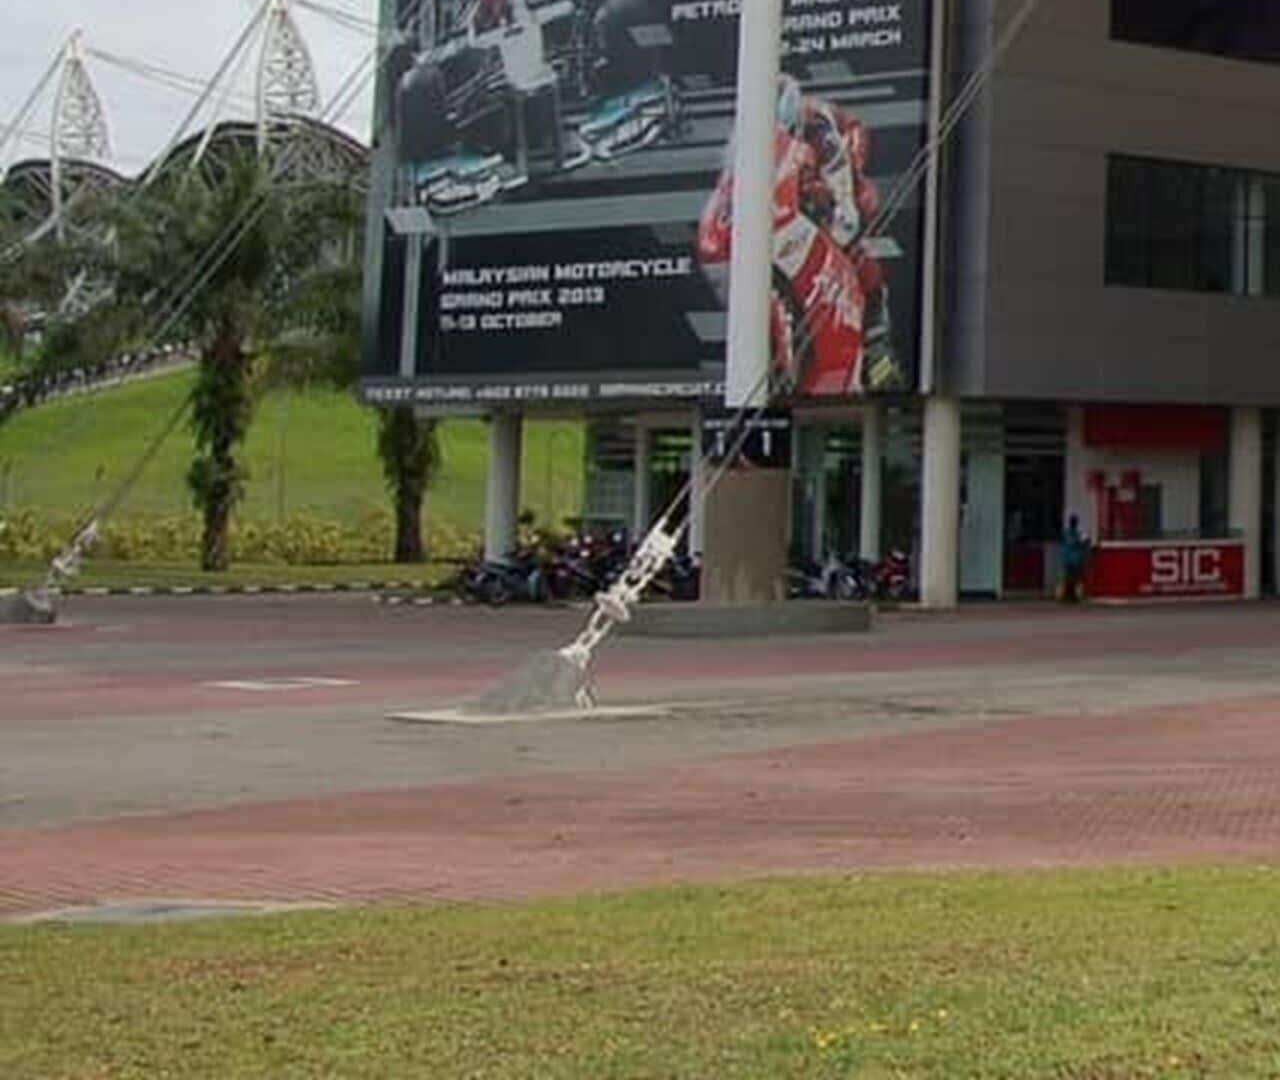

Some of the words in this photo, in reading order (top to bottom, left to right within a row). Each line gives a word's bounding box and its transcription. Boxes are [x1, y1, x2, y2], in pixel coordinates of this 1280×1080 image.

[671, 0, 742, 21] PETRO
[783, 11, 843, 33] RAND
[849, 4, 901, 25] PRIX
[830, 30, 902, 51] MARCH
[442, 266, 550, 285] MALAYSIAN
[554, 257, 692, 281] MOTORCYCLE
[439, 291, 504, 310] GRAND
[508, 288, 553, 307] PRIX
[557, 286, 605, 305] 2013
[480, 311, 563, 329] OCTOBER
[761, 430, 771, 457] 1
[1151, 548, 1220, 584] SIC
